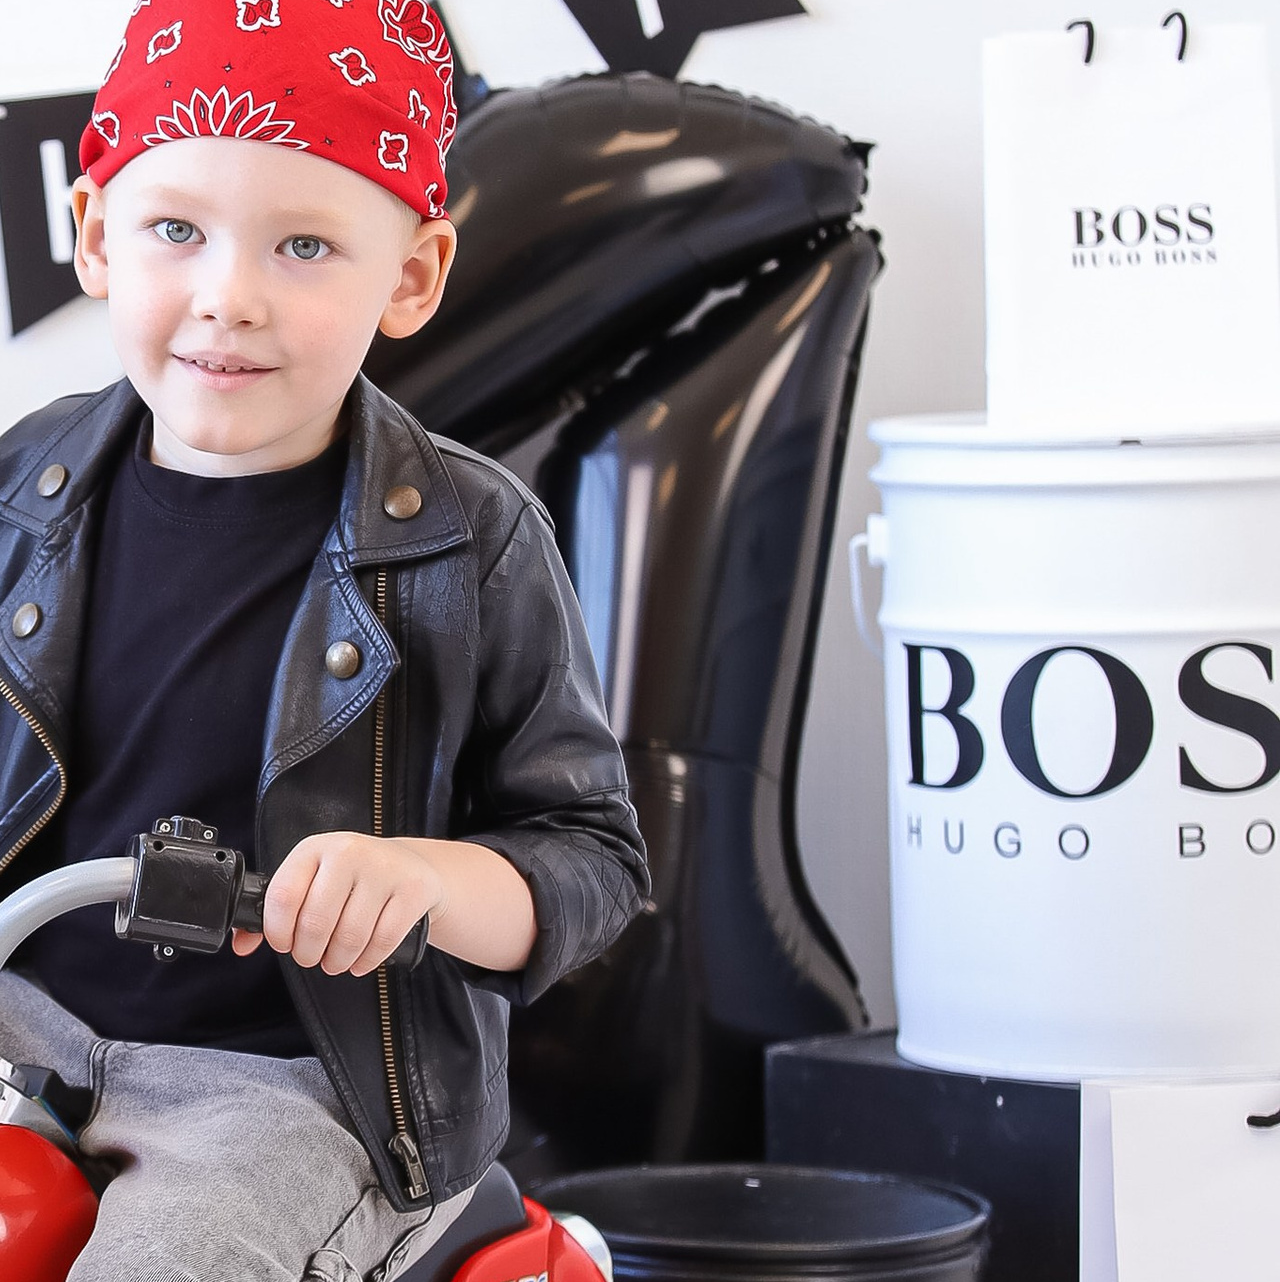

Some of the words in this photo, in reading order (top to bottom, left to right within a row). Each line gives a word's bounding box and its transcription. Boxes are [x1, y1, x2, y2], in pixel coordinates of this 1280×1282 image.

[1072, 203, 1215, 248] BOSS
[1072, 251, 1141, 268] HUGO
[1155, 249, 1218, 265] BOSS
[902, 642, 1280, 798] BOS
[906, 815, 1090, 860] HUGO
[1178, 818, 1276, 859] BO
